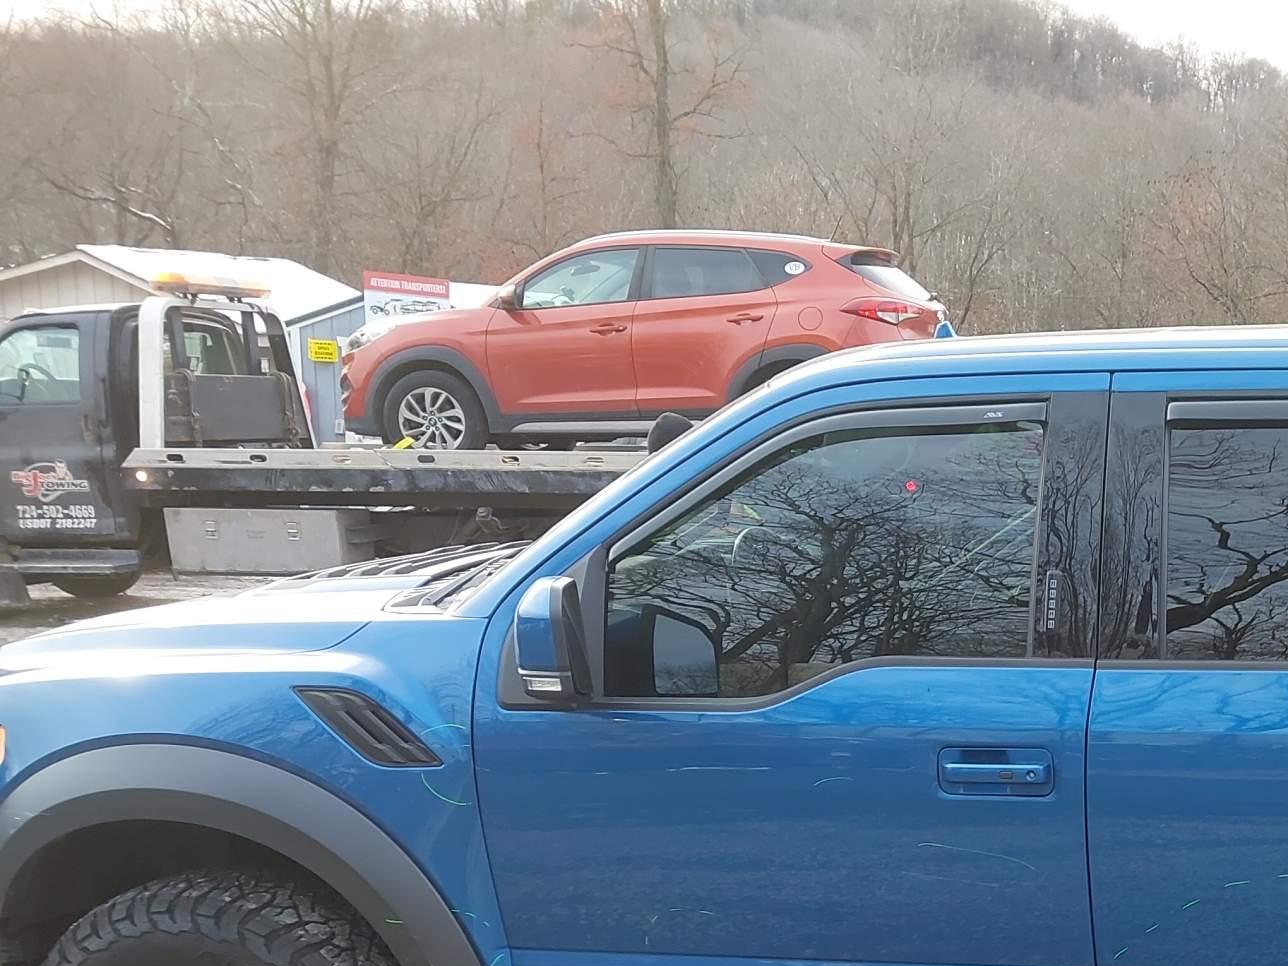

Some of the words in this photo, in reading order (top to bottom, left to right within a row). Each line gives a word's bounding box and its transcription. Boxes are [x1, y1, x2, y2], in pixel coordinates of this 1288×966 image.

[370, 277, 400, 289] ATTENTION
[40, 480, 88, 490] TOWING
[19, 519, 52, 528] USDOT
[56, 519, 97, 528] 2182247
